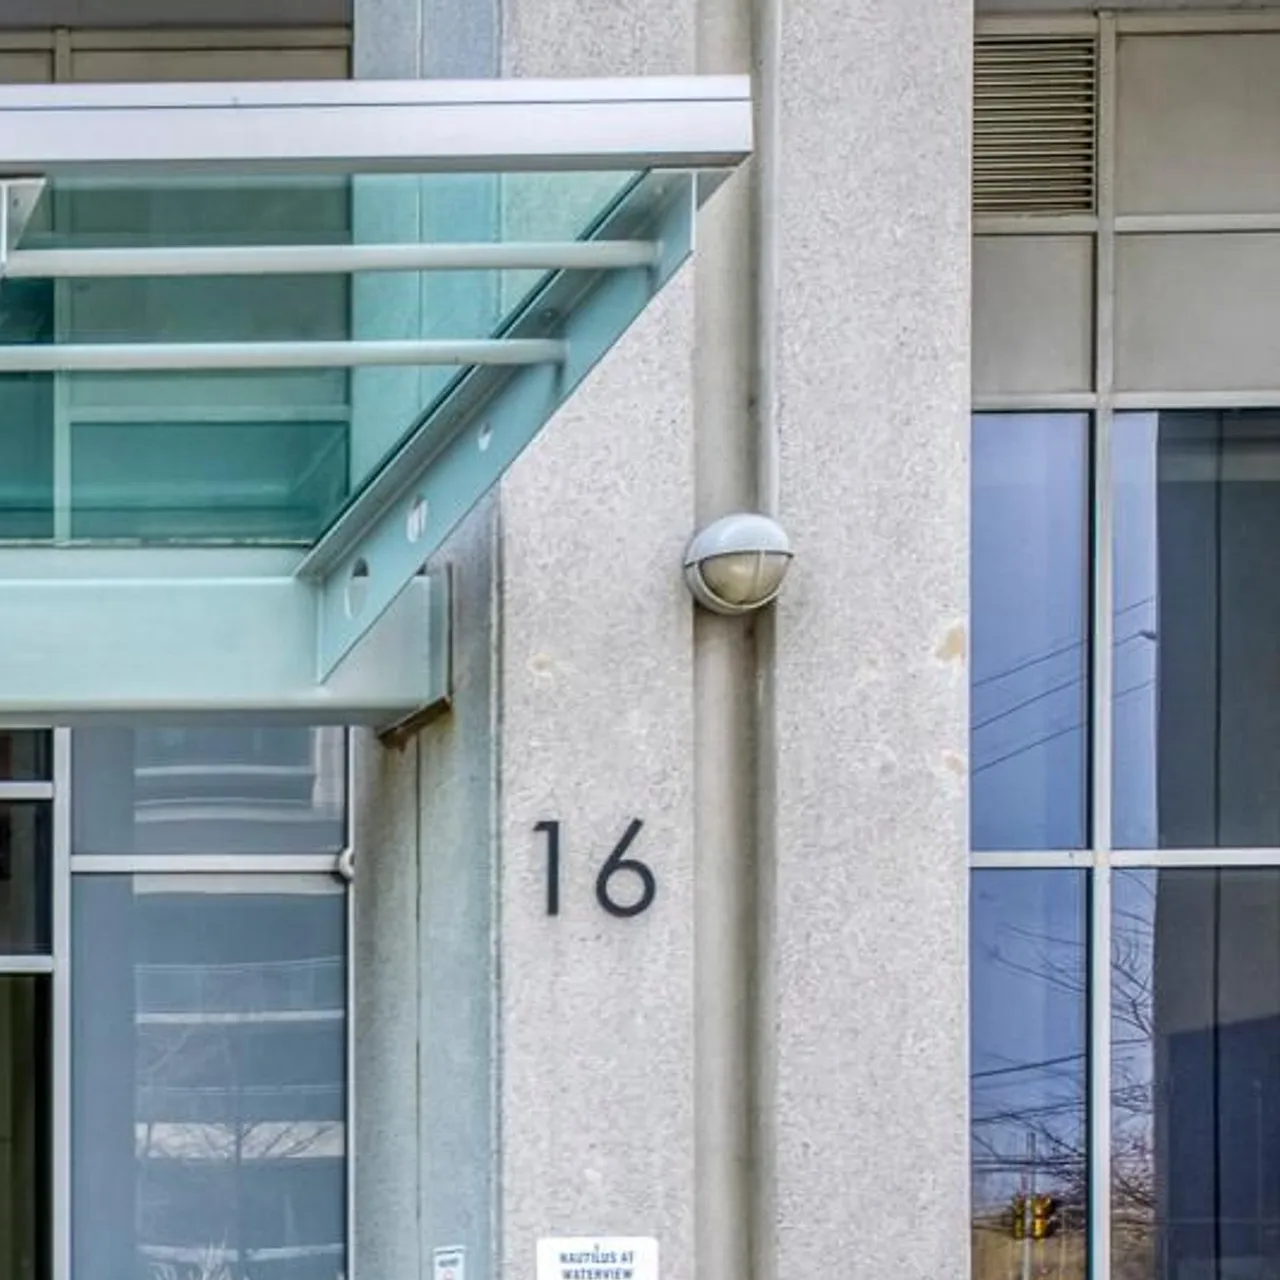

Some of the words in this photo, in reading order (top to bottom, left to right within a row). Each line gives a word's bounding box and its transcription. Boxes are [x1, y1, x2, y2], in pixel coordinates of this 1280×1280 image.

[533, 818, 656, 918] 16
[560, 1252, 616, 1263] NAUTILUS
[621, 1252, 633, 1263] AT
[562, 1269, 633, 1280] WATERVIEW
